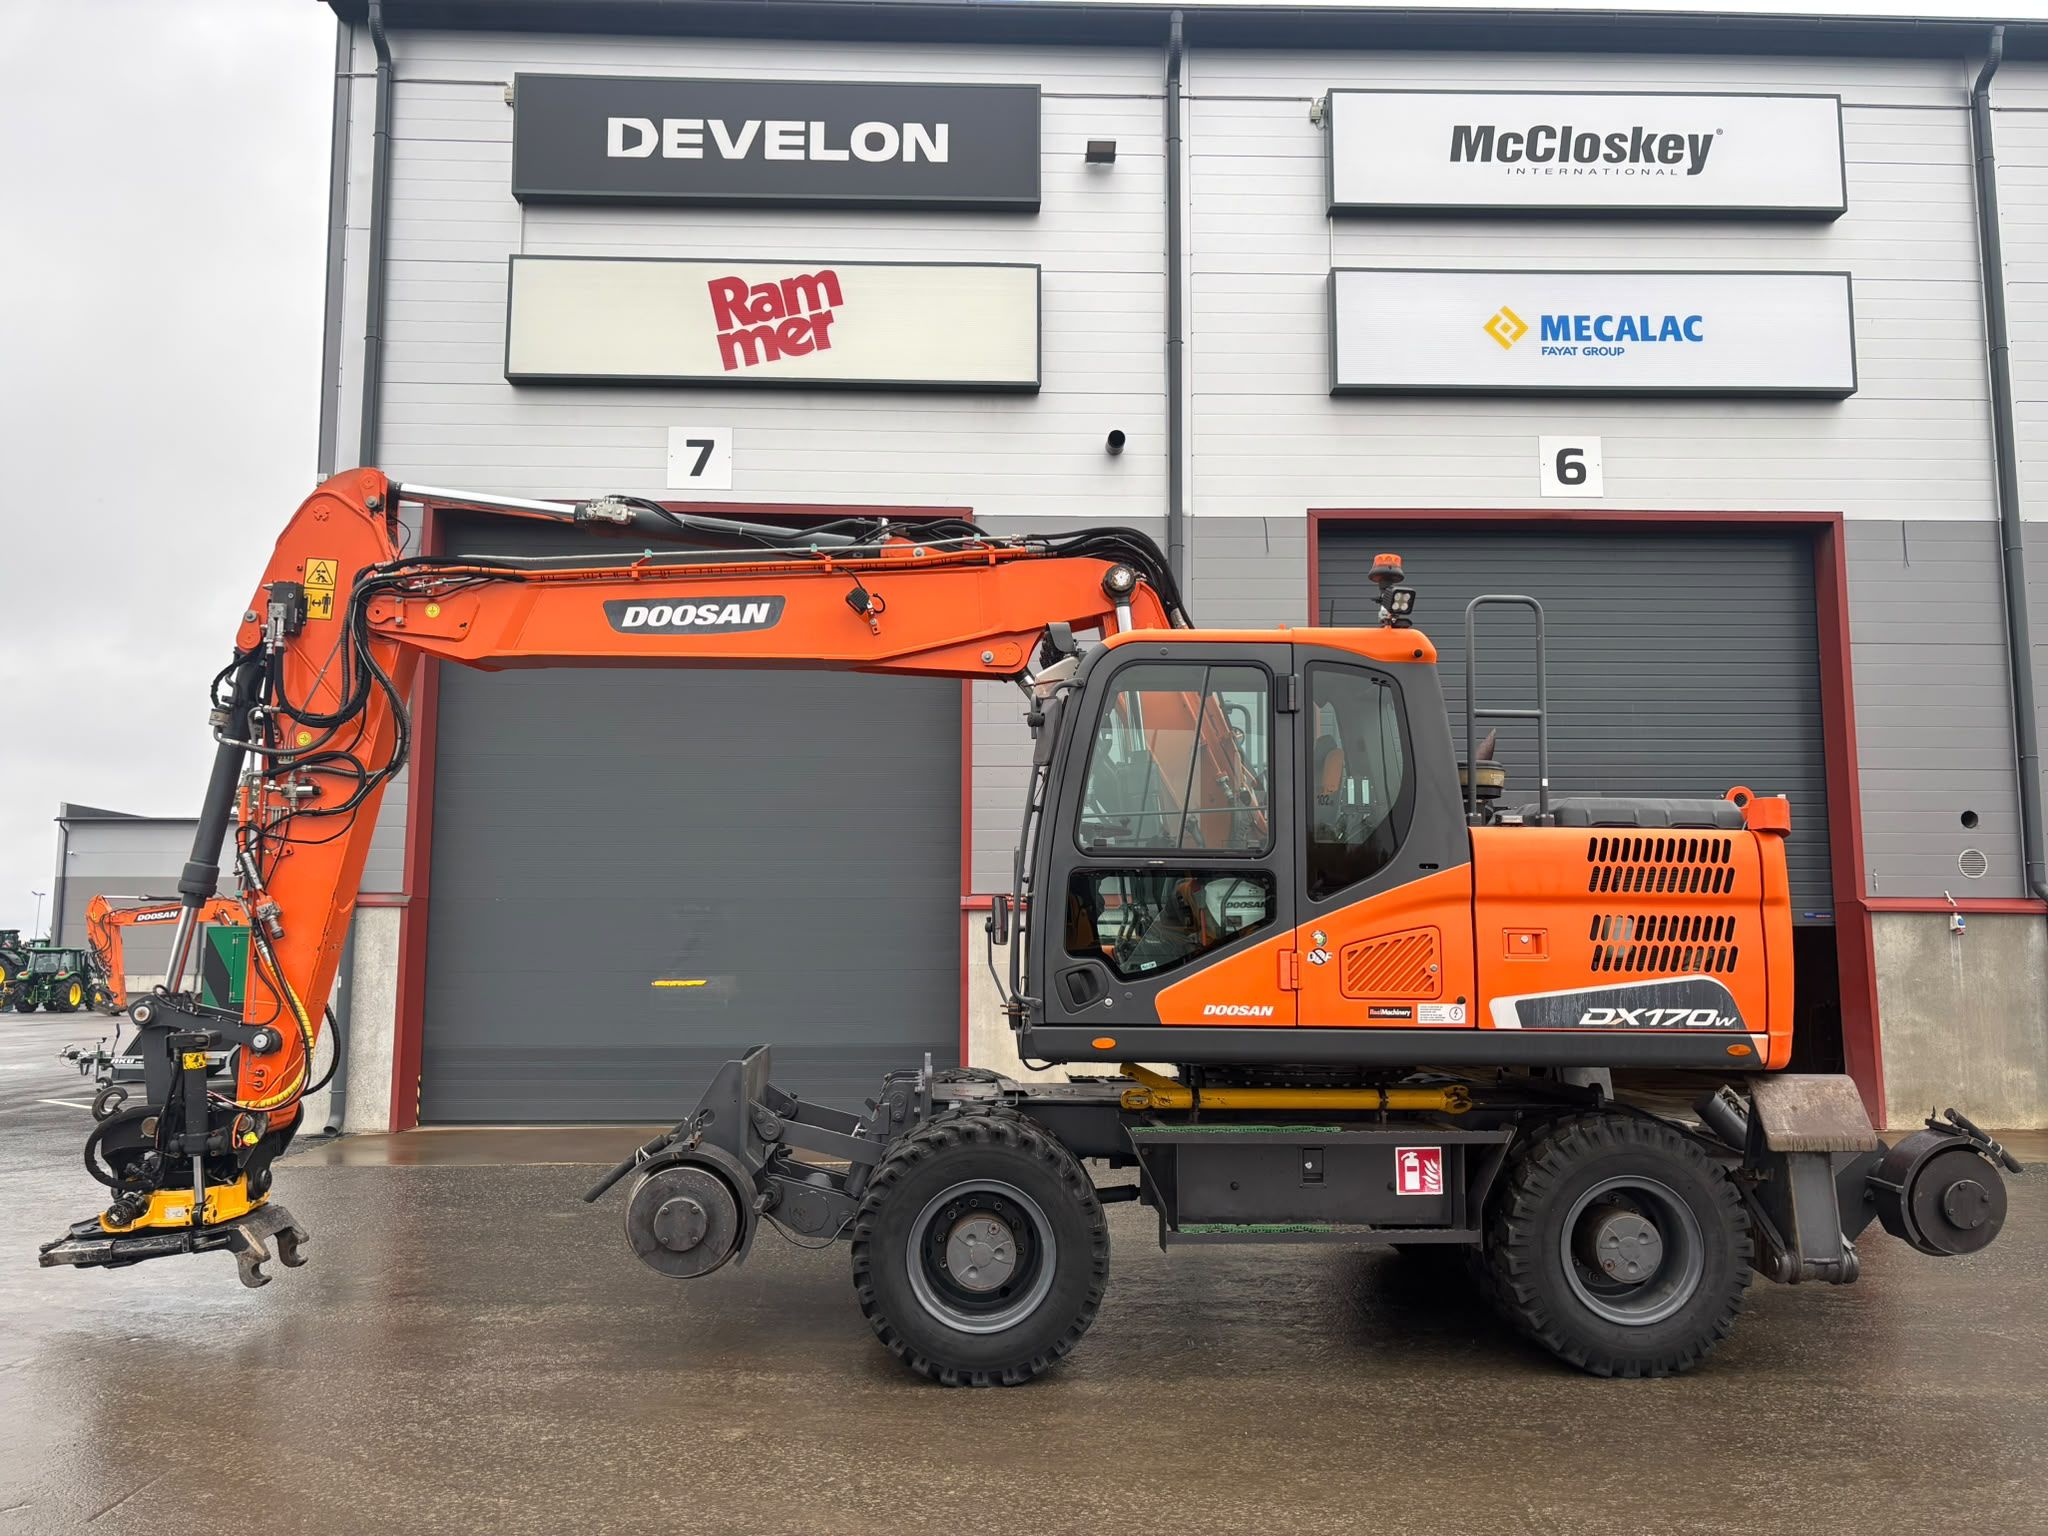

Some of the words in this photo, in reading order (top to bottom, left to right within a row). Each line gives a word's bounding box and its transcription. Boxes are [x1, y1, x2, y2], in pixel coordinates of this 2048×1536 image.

[607, 116, 949, 163] DEVELON
[1450, 125, 1714, 176] McCloskey
[1507, 167, 1678, 176] INTERNATIONAL
[1540, 314, 1704, 342] MECALAC
[1541, 346, 1579, 356] FAYAT
[1582, 346, 1625, 357] GROUP
[686, 438, 715, 477] 7
[1555, 447, 1587, 486] 6
[621, 602, 771, 627] DOOSAN
[136, 910, 178, 922] DOOSAN
[1203, 1004, 1274, 1017] DOOSAN
